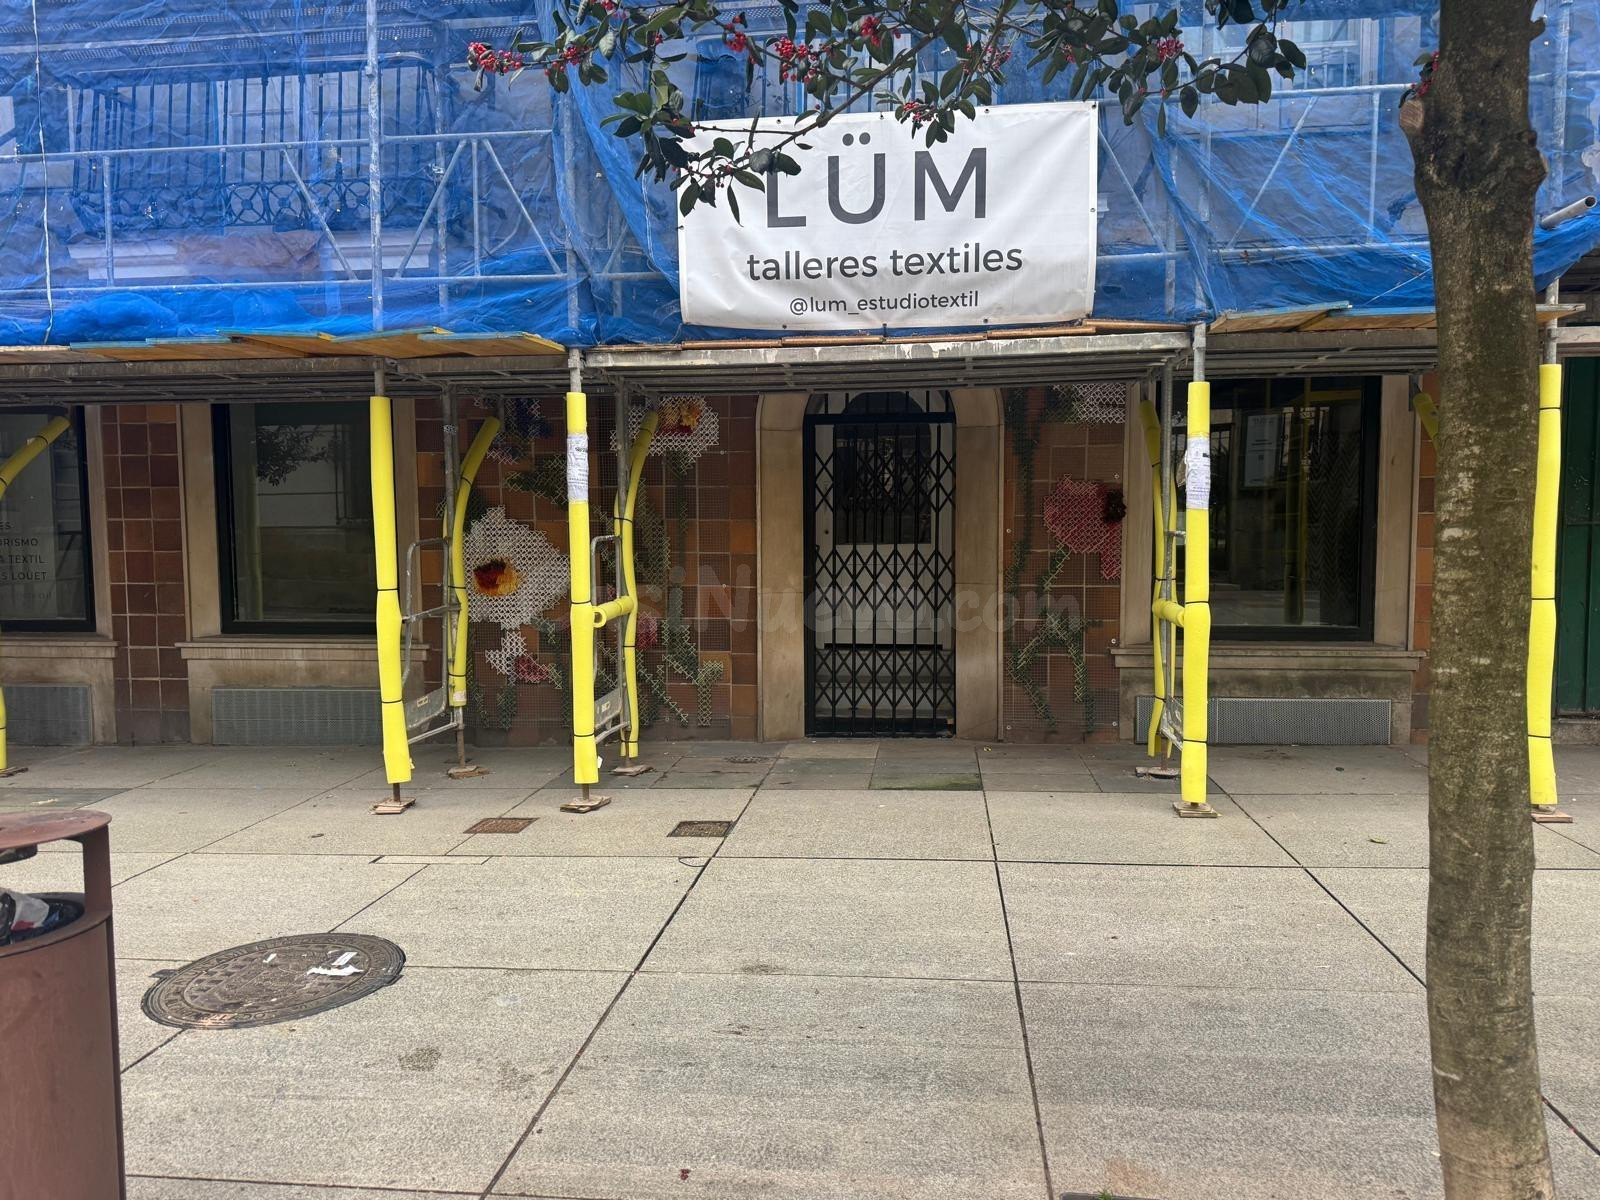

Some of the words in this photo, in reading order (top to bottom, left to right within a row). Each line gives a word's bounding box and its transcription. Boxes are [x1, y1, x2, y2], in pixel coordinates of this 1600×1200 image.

[766, 132, 987, 228] LÜM
[747, 250, 878, 281] talleres
[889, 242, 1023, 277] textiles
[789, 291, 979, 317] @lum_estudiotextil
